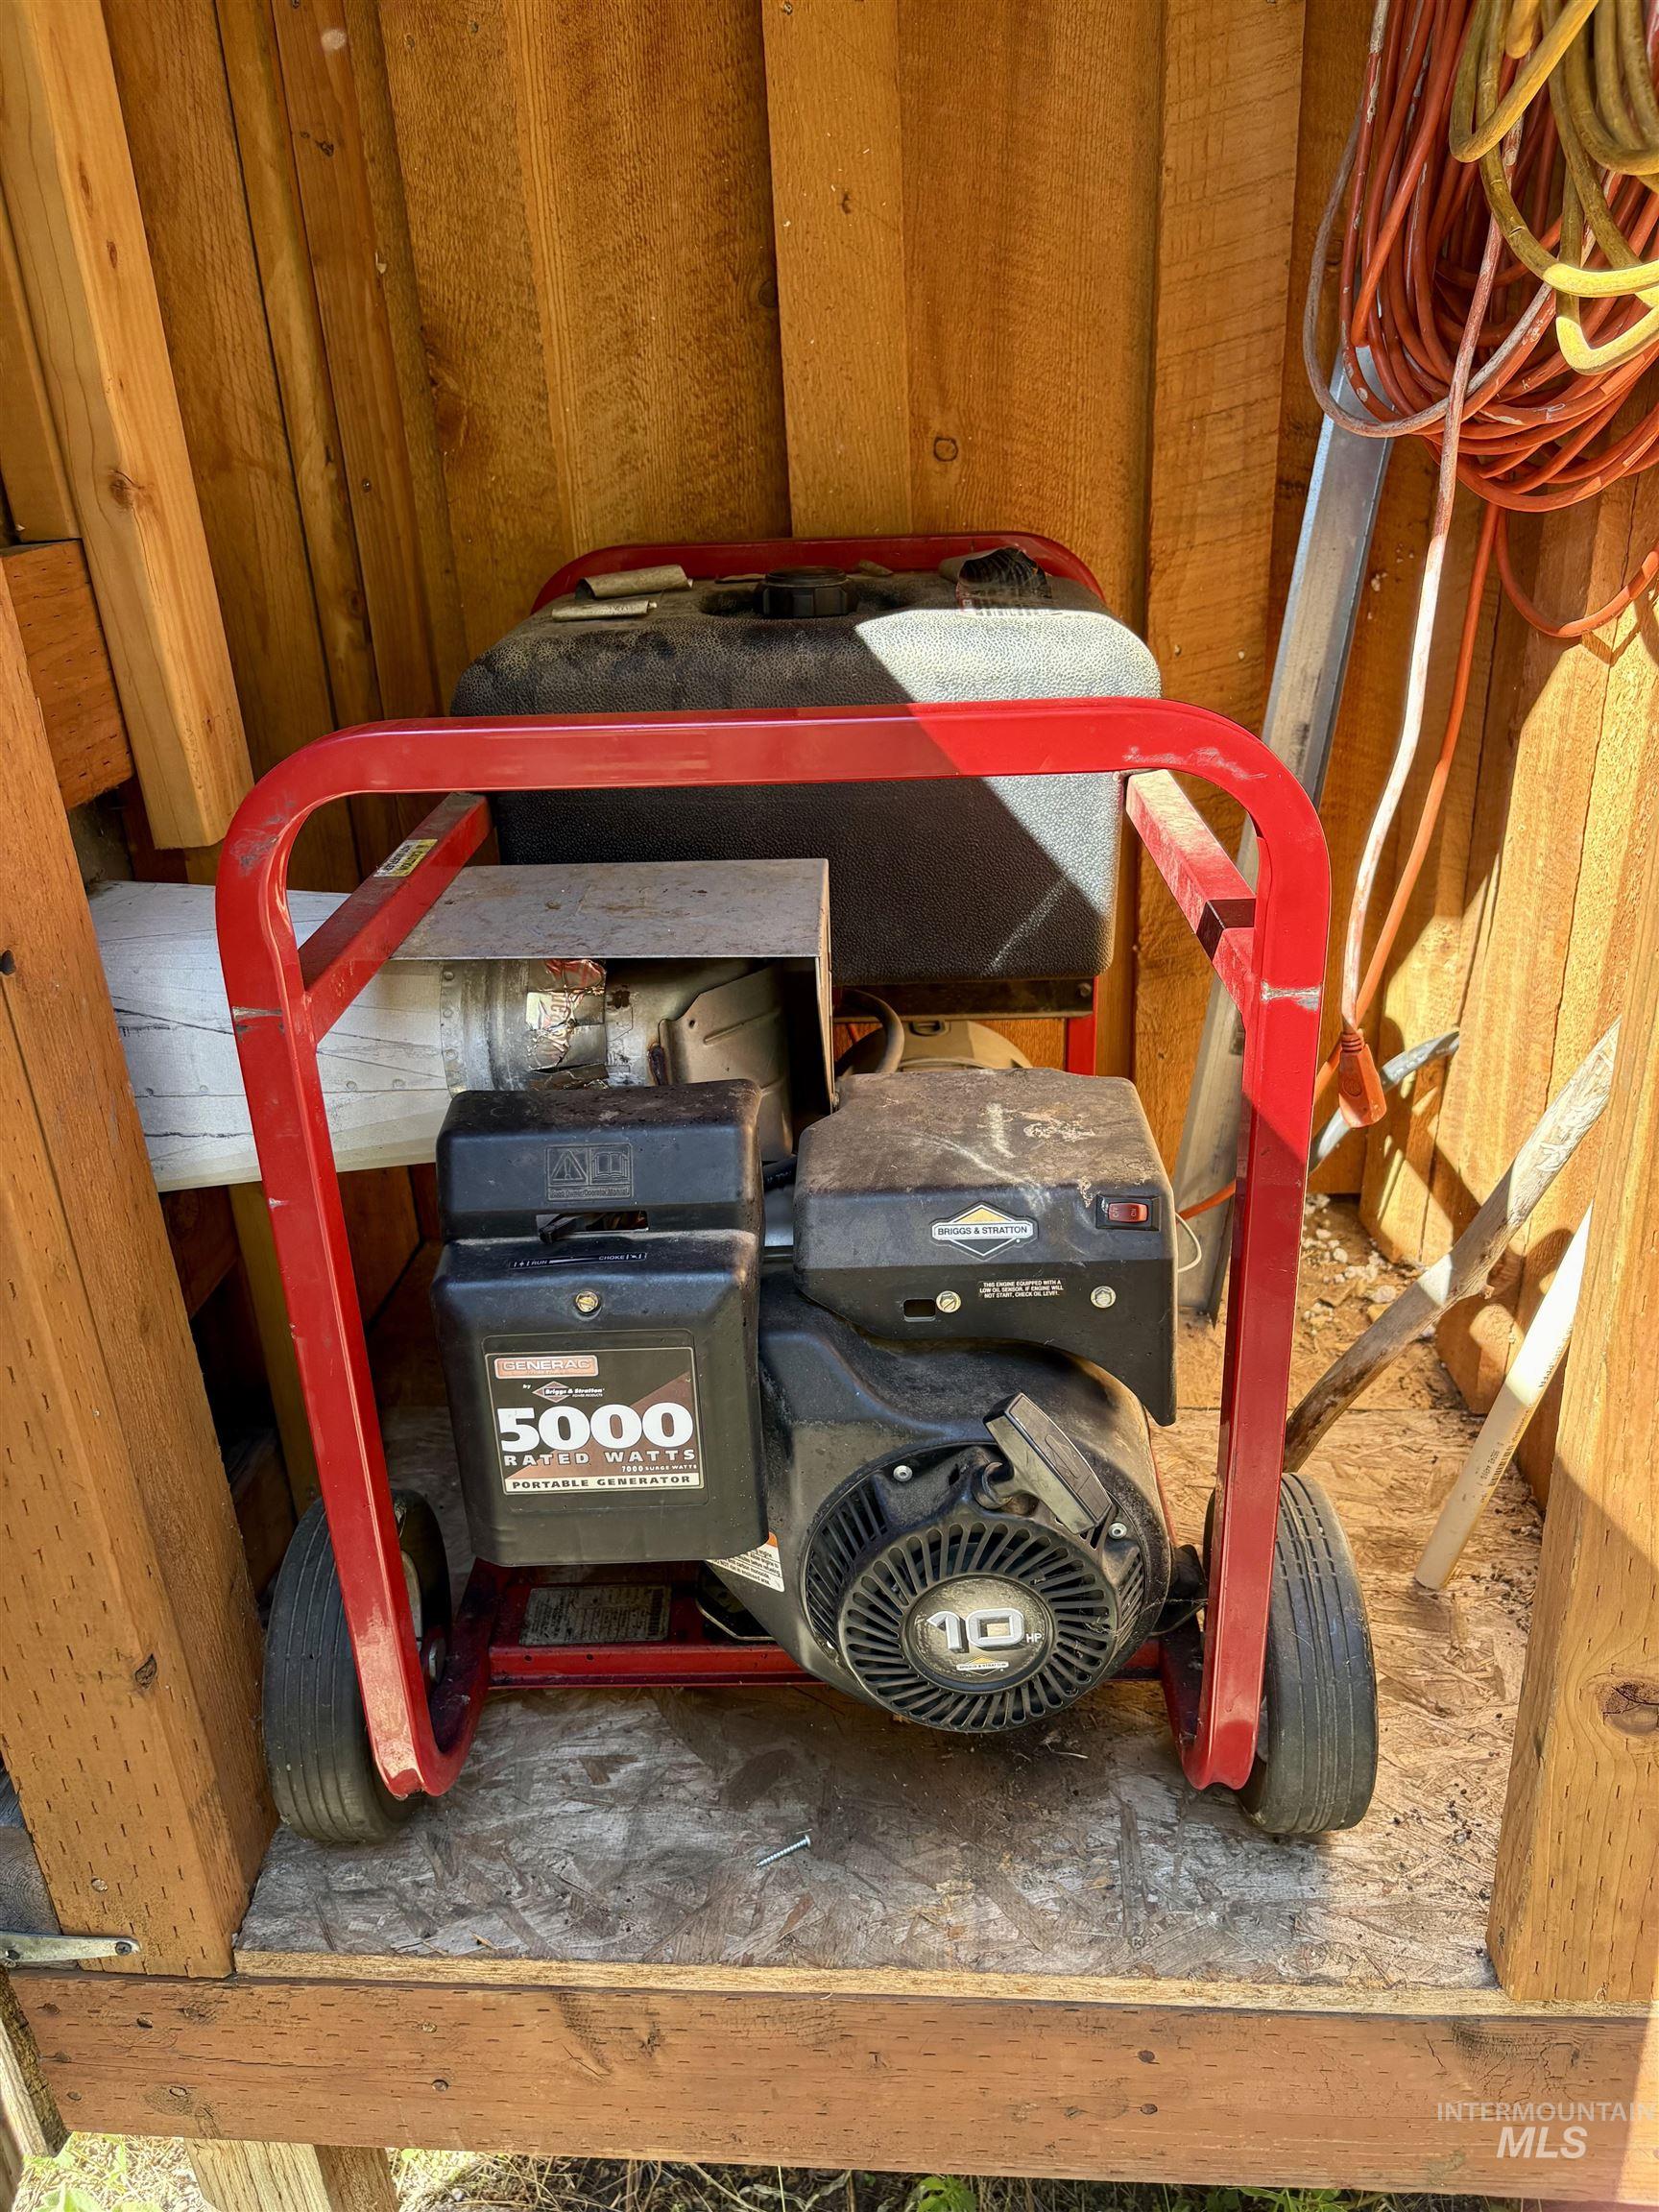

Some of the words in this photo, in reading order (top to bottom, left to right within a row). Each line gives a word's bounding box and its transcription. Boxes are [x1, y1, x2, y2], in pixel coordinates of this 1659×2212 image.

[937, 1227, 972, 1236] BRIGGS
[981, 1225, 1027, 1235] STRATTON
[503, 1358, 591, 1371] GENERAC
[497, 1402, 694, 1453] 5000
[504, 1452, 591, 1467] RATED
[604, 1449, 696, 1464] WATTS
[512, 1479, 589, 1490] PORTABLE
[596, 1475, 691, 1487] GENERATOR
[926, 1608, 1024, 1649] 10
[1026, 1633, 1043, 1644] HP
